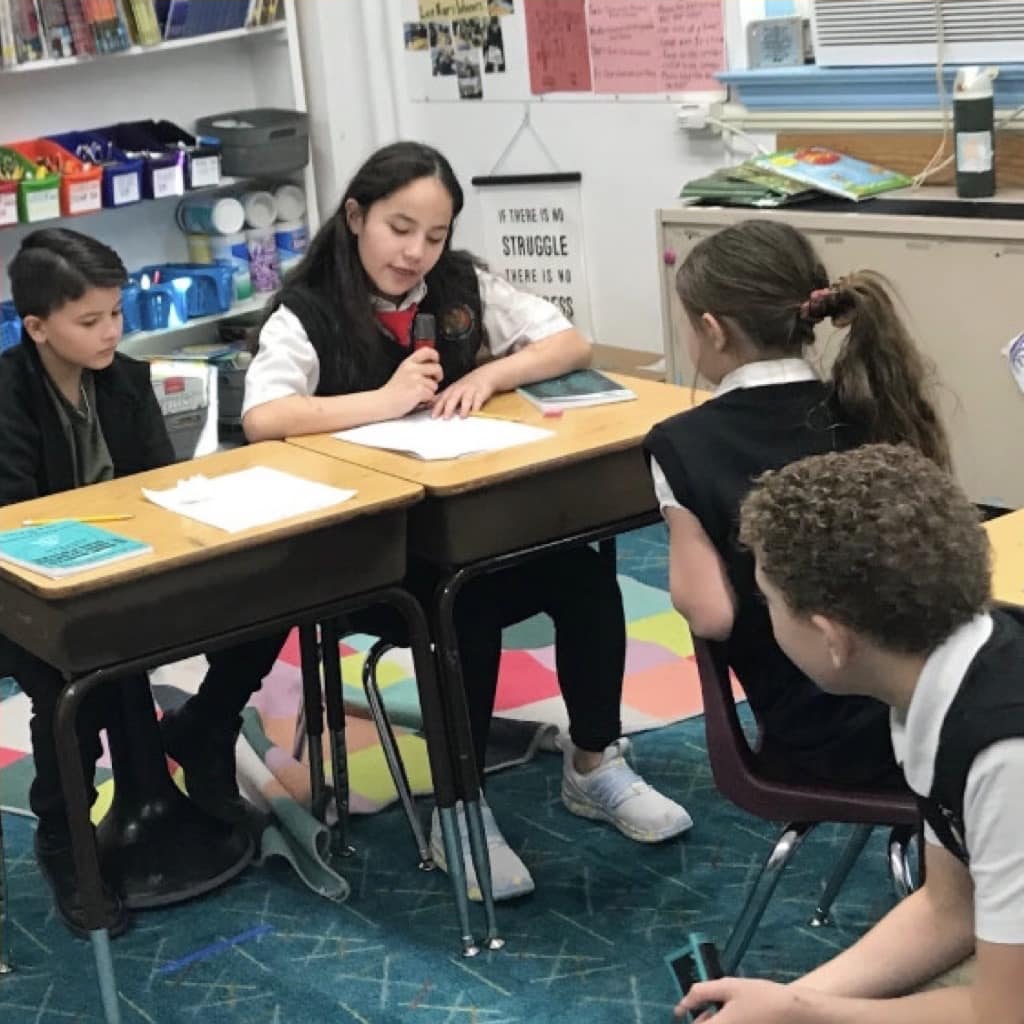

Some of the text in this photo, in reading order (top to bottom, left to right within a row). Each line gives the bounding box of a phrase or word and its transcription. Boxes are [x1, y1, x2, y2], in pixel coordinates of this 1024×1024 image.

[498, 207, 564, 224] IF THERE IS NO
[502, 234, 568, 256] STRUGGLE
[504, 268, 572, 284] THERE IS NO
